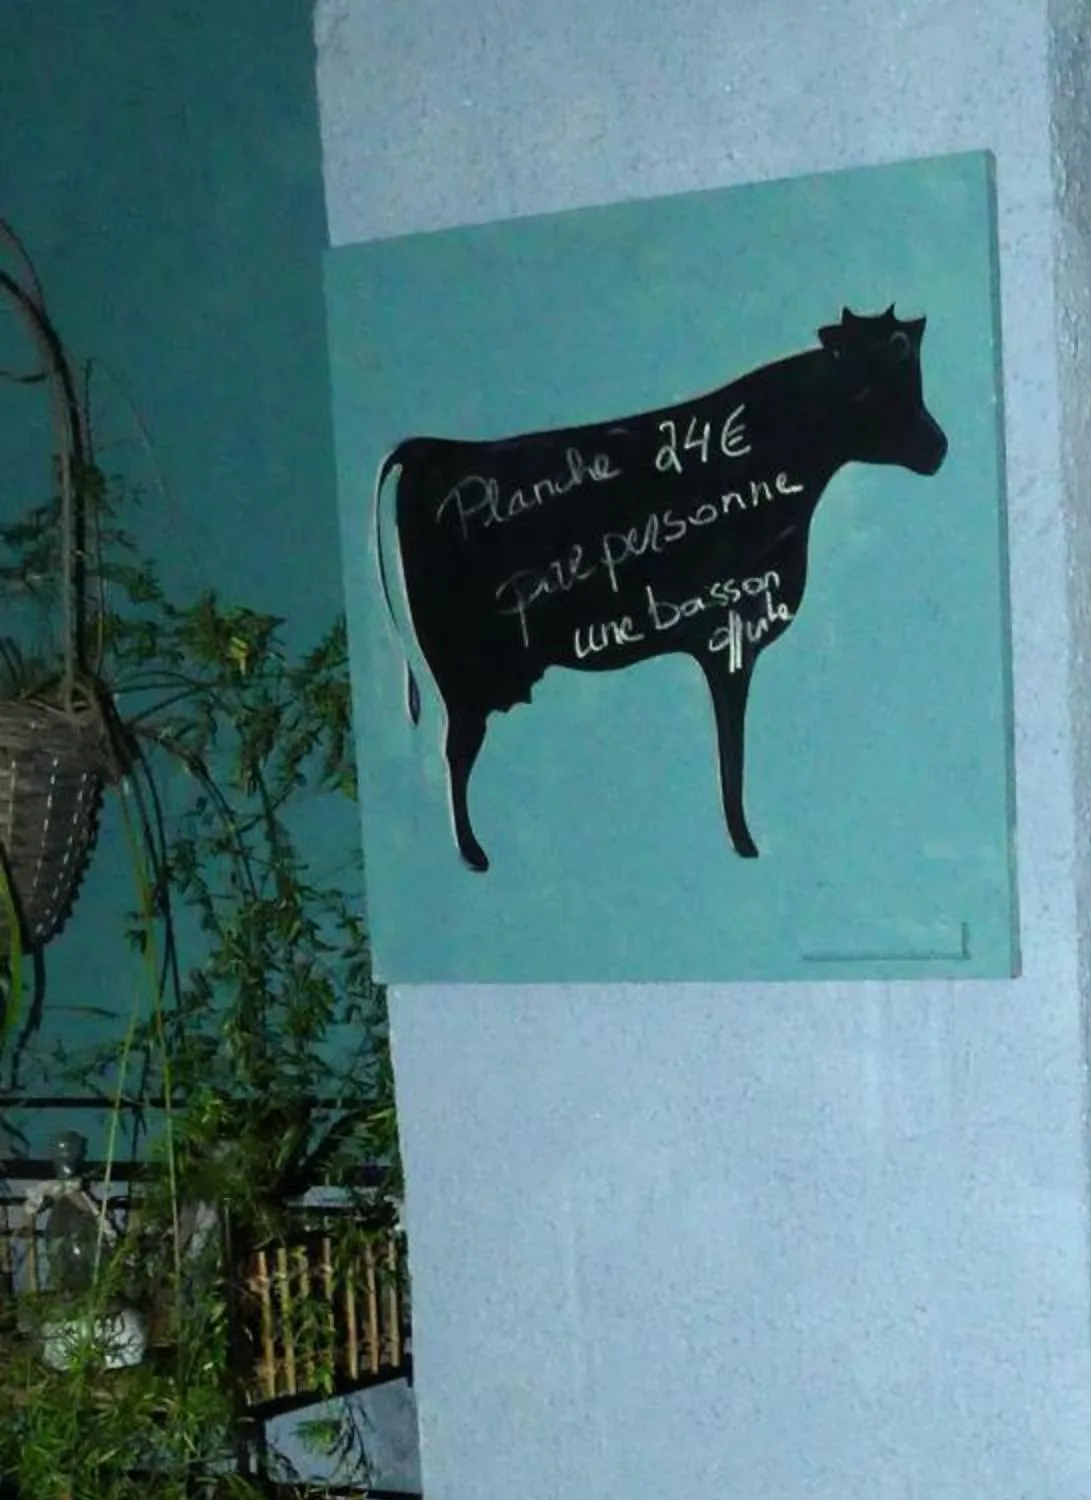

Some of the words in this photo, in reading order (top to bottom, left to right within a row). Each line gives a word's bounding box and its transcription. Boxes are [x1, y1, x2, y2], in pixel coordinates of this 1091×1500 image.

[435, 447, 622, 541] Planche
[601, 471, 805, 593] personne
[575, 615, 645, 659] une
